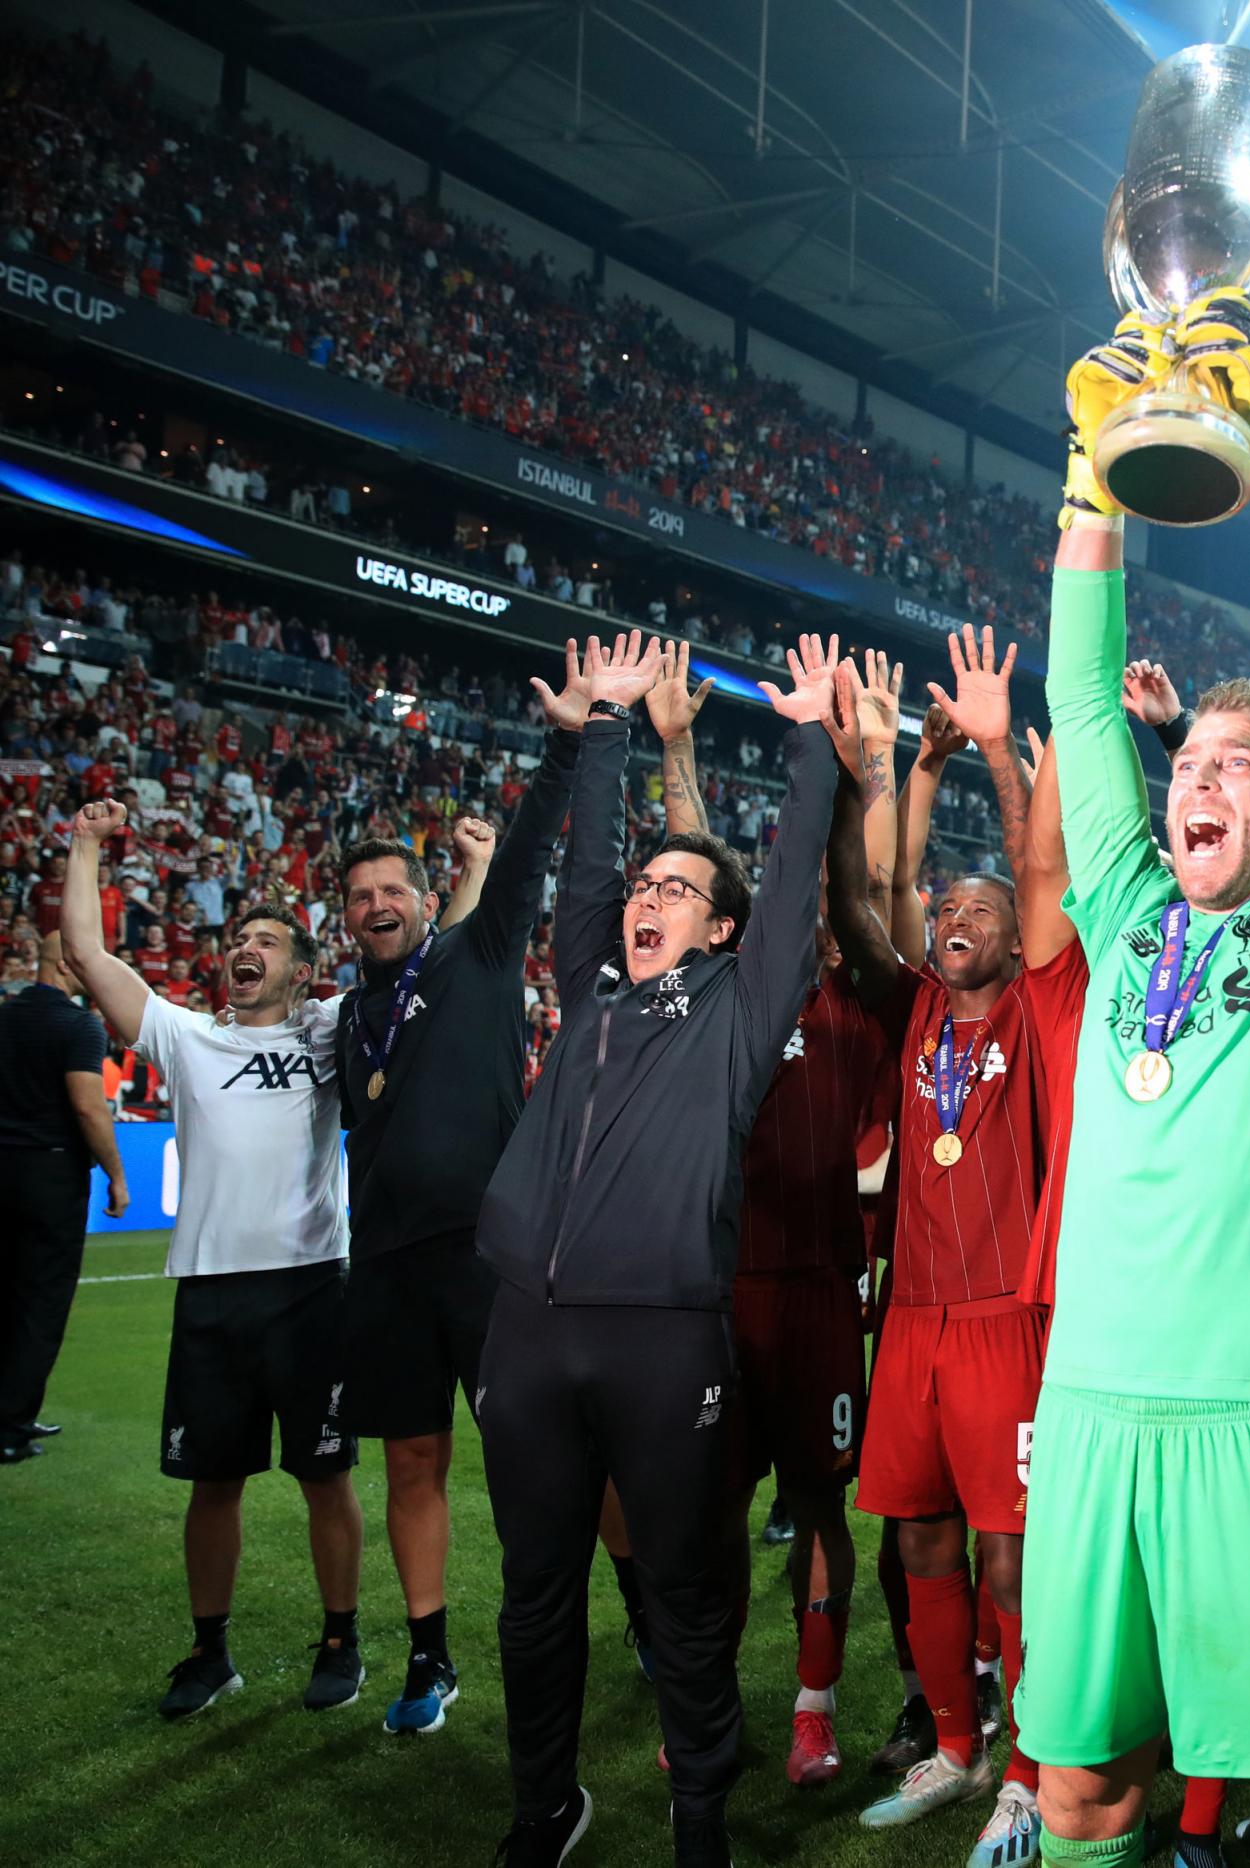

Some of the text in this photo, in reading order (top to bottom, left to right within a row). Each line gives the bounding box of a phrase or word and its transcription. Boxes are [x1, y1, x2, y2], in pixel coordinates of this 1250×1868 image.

[53, 286, 117, 325] CUP
[518, 457, 684, 537] ISTANBUL 2019
[356, 556, 508, 617] UEFA SUPER CUP
[895, 598, 928, 623] UEFA
[1156, 968, 1172, 991] 2019
[396, 989, 407, 1005] 2019
[219, 1051, 323, 1090] AXA
[941, 1093, 950, 1111] 2019
[702, 1385, 722, 1405] JLP
[831, 1392, 853, 1452] 9
